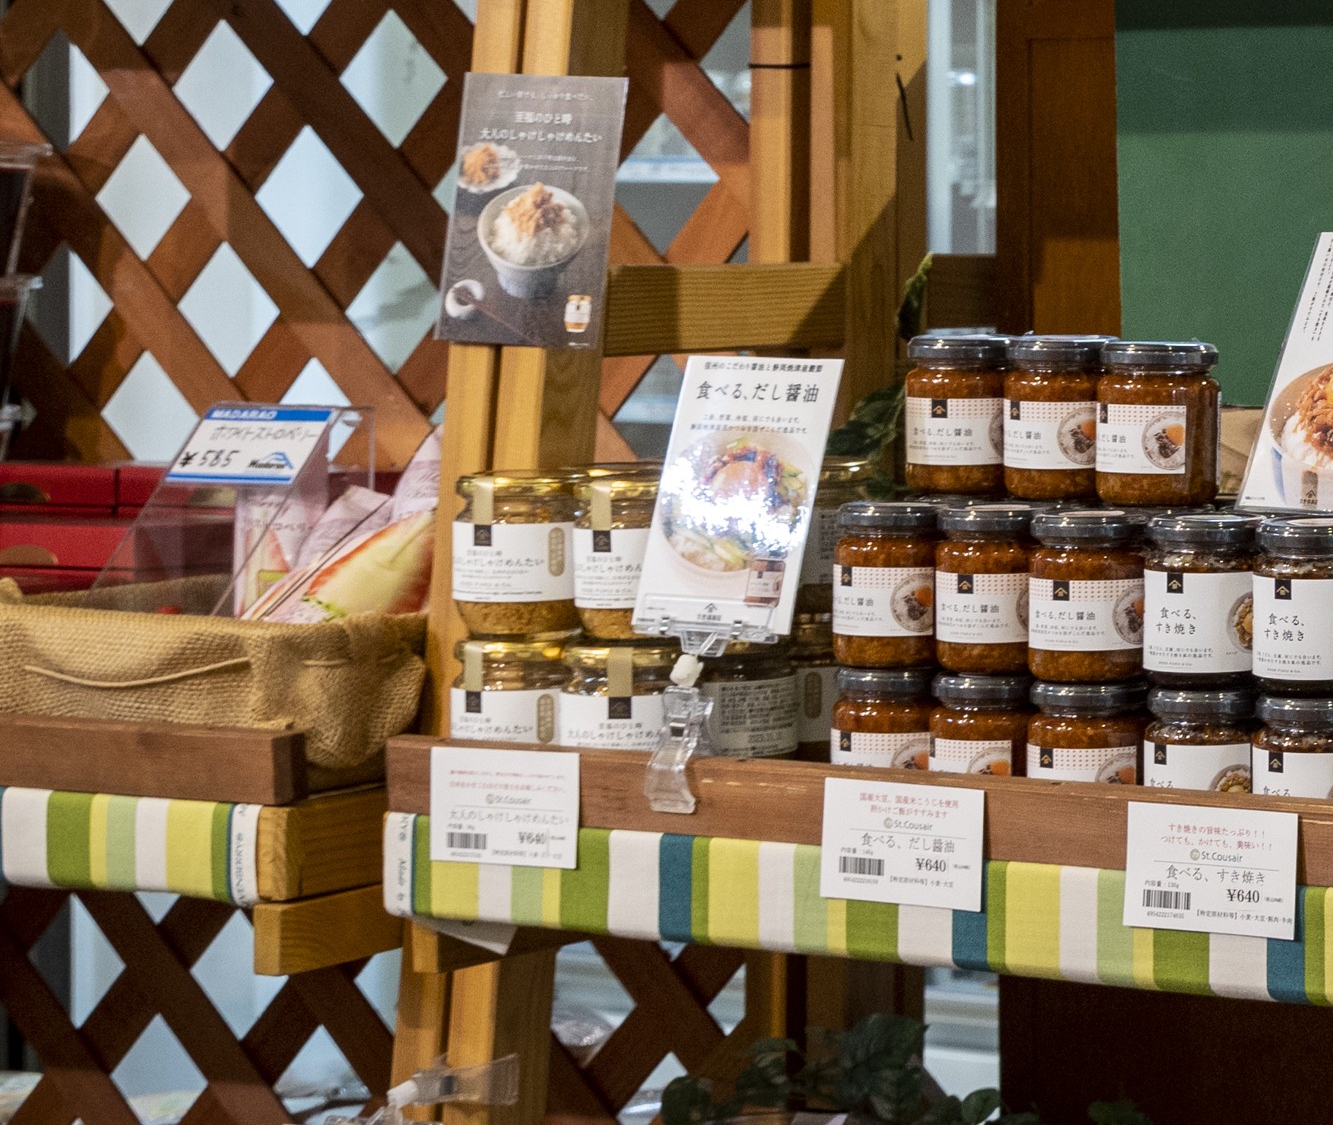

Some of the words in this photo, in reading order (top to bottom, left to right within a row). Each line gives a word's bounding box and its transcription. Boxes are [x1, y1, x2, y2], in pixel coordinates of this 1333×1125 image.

[695, 380, 820, 403] 食べる、だし醤油
[518, 831, 547, 844] ¥640
[861, 833, 955, 853] 食べる、だし醤油
[1201, 851, 1243, 863] St.Cousair
[916, 858, 946, 872] ¥640
[1166, 865, 1266, 886] 食べる、すき焼き
[1226, 889, 1260, 903] ¥640
